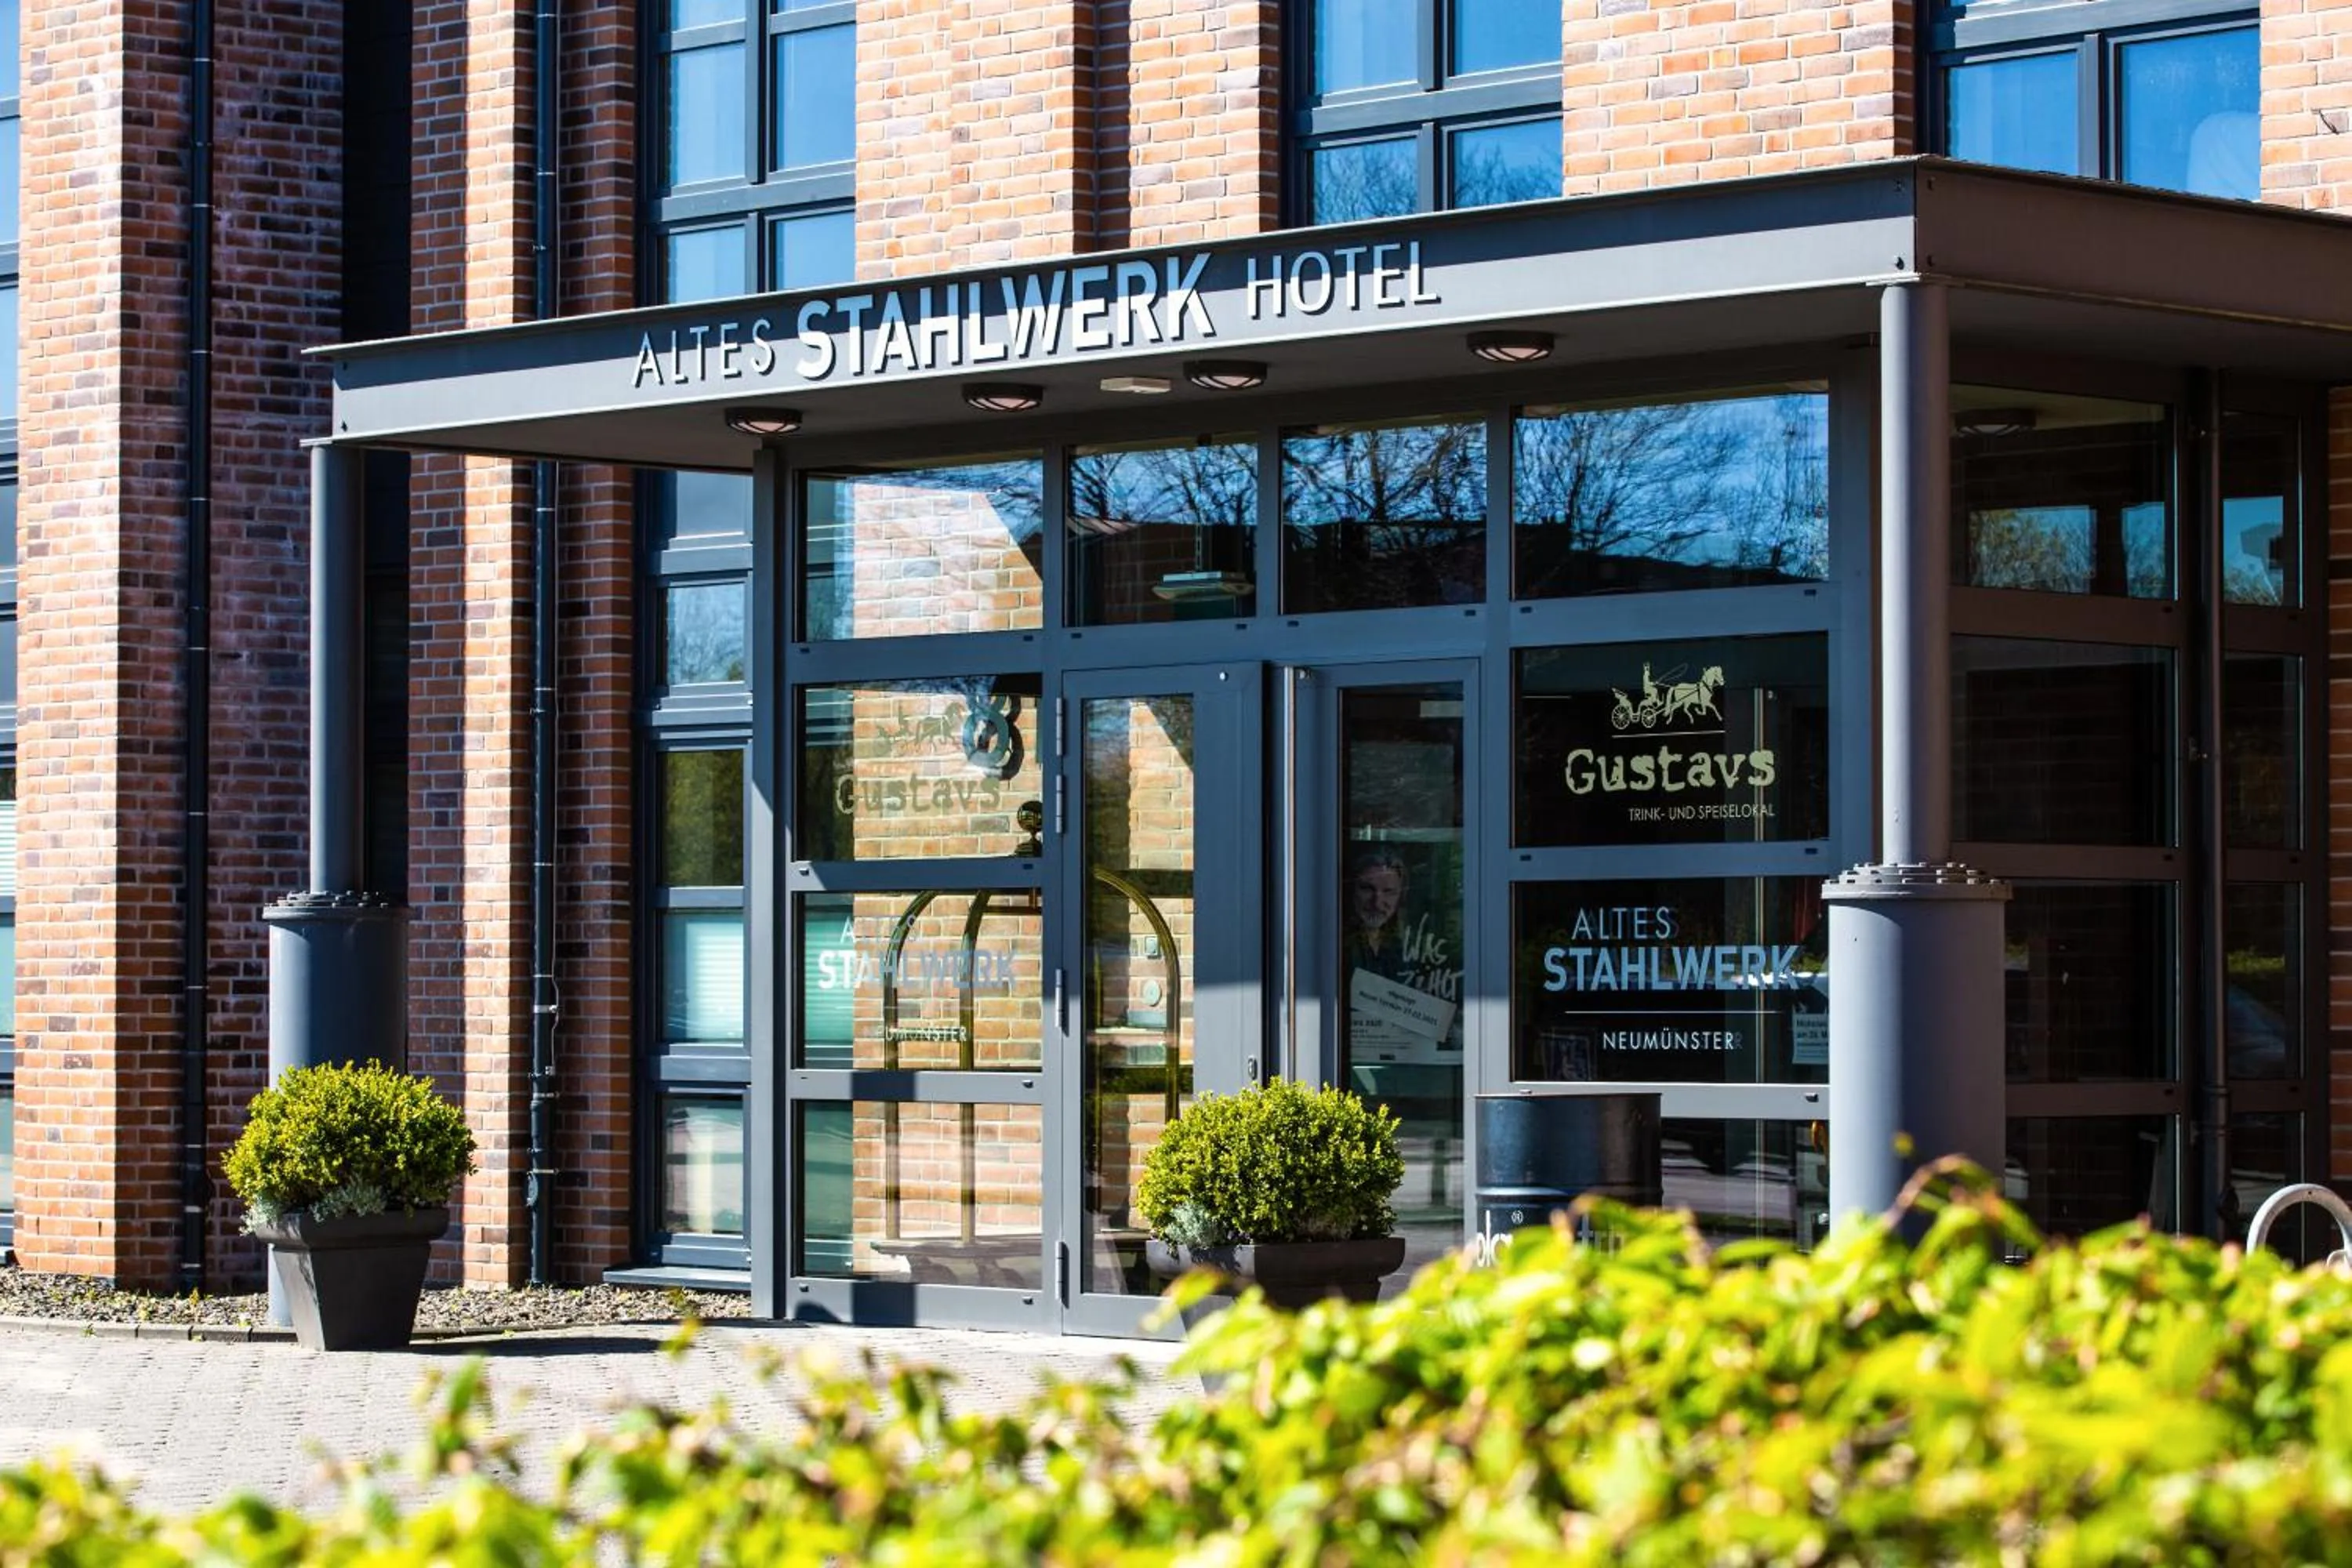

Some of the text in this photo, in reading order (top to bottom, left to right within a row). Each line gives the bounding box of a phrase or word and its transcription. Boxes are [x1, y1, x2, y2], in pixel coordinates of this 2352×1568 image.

[632, 241, 1441, 387] ALTES STAHLWERK HOTEL
[1565, 746, 1776, 795] Gustavs
[835, 772, 1000, 815] Gustavs
[1629, 804, 1776, 822] TRINK- UND SPEISELOKAL
[1571, 906, 1672, 941] ALTES
[818, 949, 1017, 989] STAHLWERK
[1544, 946, 1799, 992] STAHLWERK
[1602, 1027, 1734, 1051] NEUMÜNSTER
